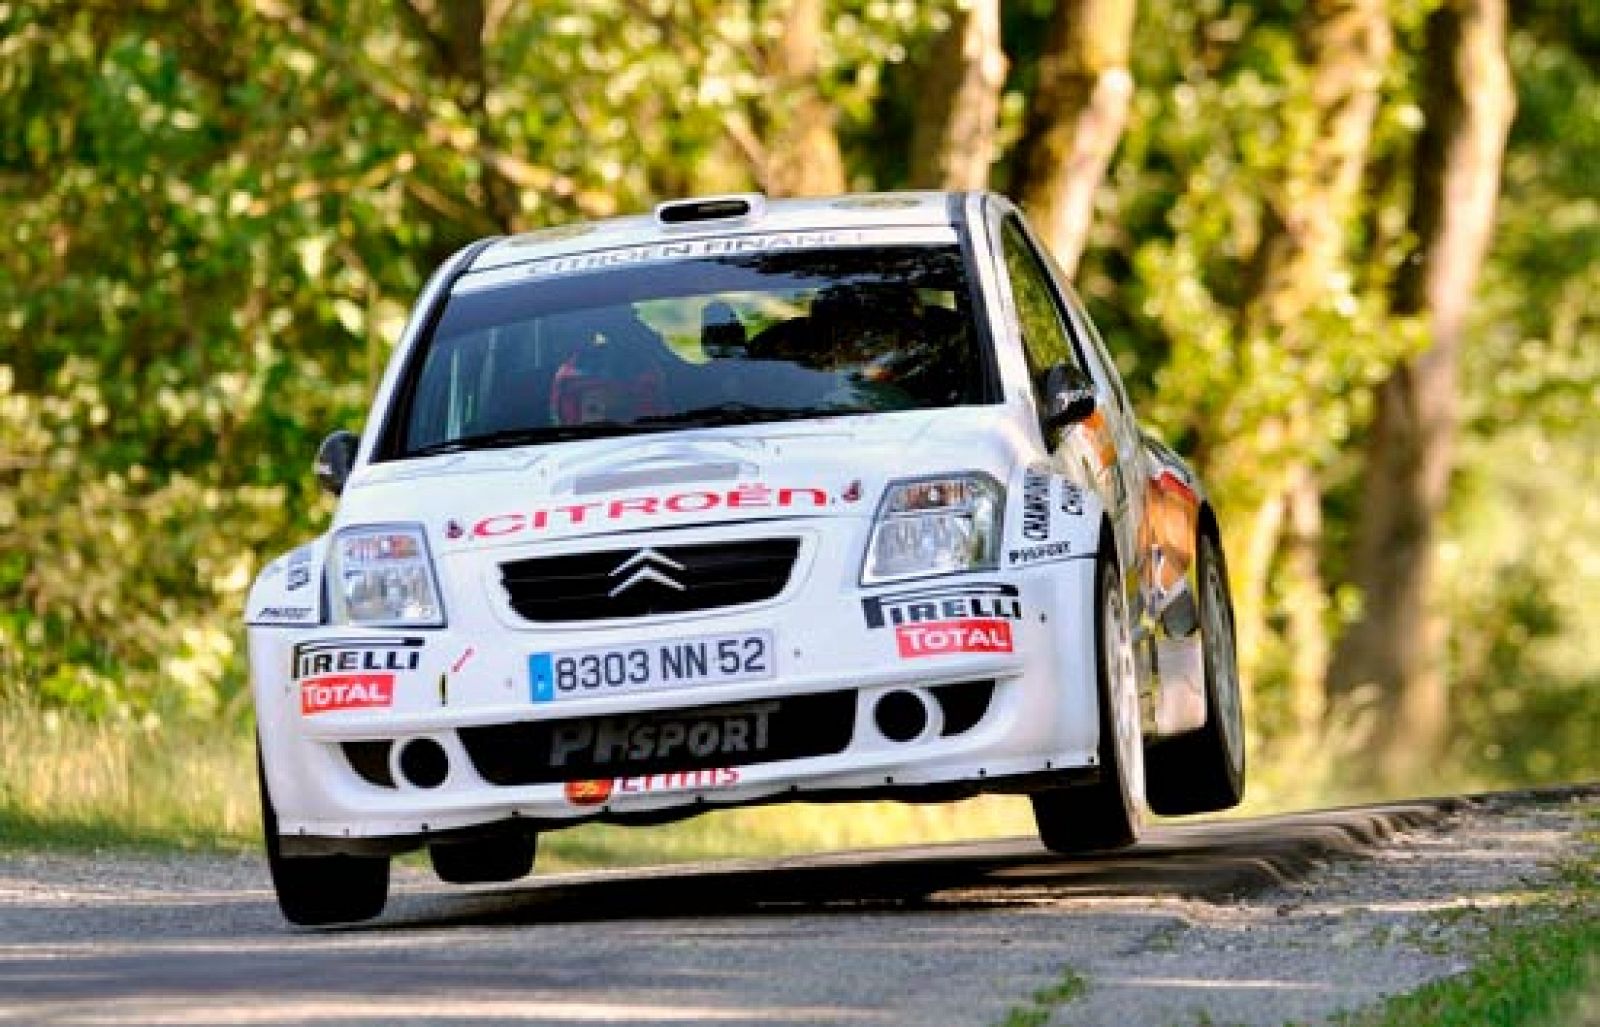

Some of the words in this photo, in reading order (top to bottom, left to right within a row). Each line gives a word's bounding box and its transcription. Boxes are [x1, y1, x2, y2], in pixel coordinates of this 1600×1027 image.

[473, 483, 828, 537] CITROËN
[861, 582, 1022, 629] PIRELLI
[291, 637, 425, 681] PIRELLI
[903, 627, 1009, 650] TOTAL
[555, 649, 650, 692] 8303
[659, 642, 708, 681] NN
[717, 637, 766, 674] 52
[304, 681, 387, 705] TOTAL
